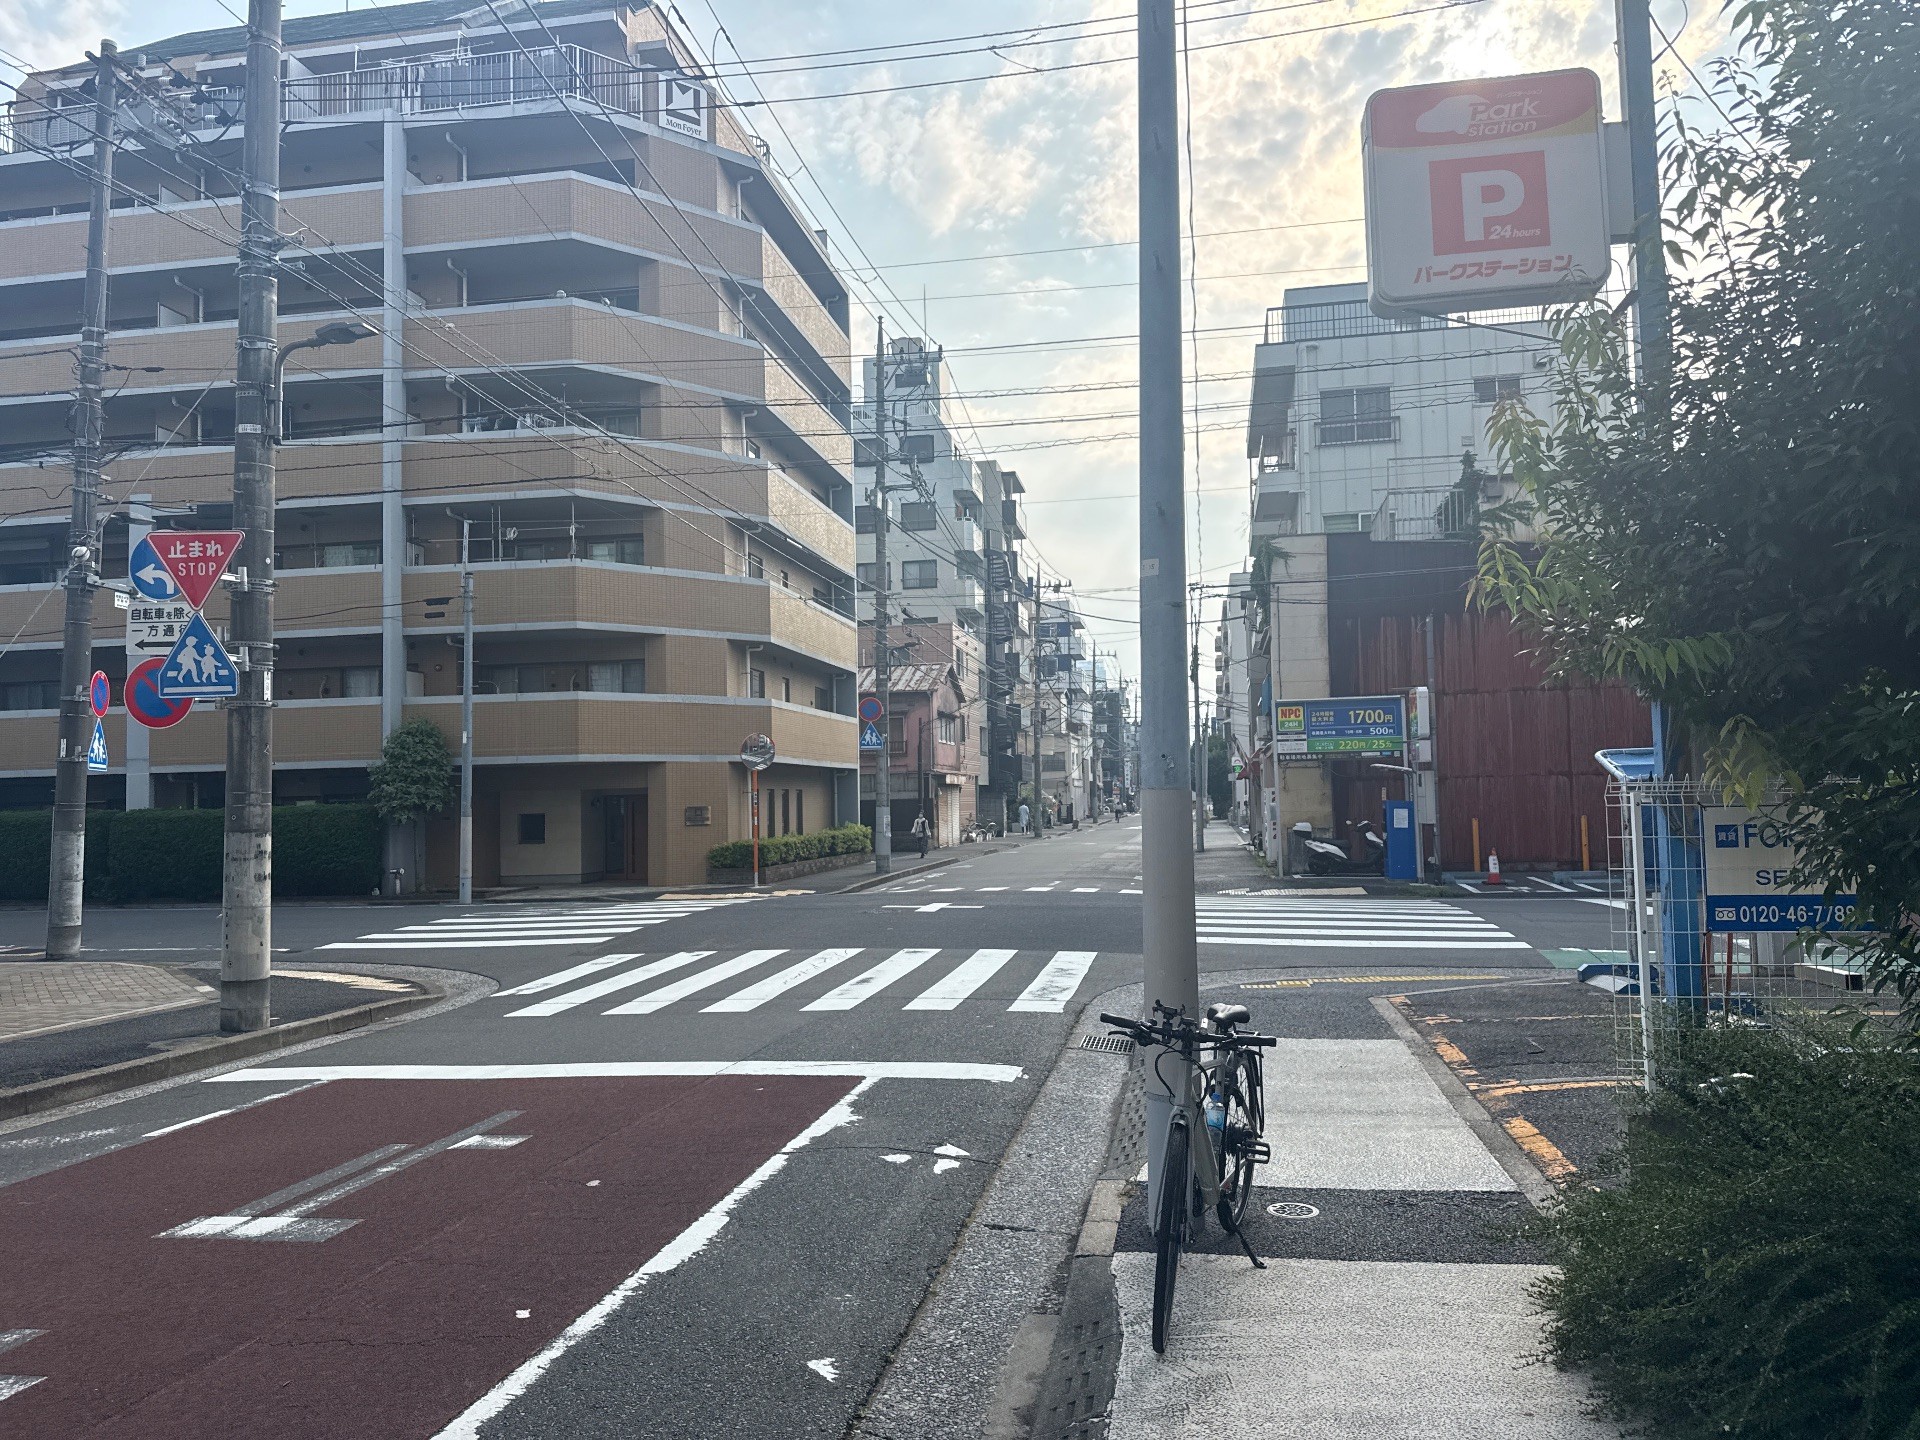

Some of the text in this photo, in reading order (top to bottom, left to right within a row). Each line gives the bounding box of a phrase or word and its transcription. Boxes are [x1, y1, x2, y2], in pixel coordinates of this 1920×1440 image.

[1470, 97, 1540, 122] Park
[1468, 120, 1537, 137] station
[1460, 169, 1525, 242] P
[1489, 224, 1541, 240] 24 hours
[1413, 255, 1573, 284] パークステーション
[168, 540, 225, 558] 止まれ
[178, 562, 217, 576] STOP
[131, 607, 192, 621] 自転車を除く
[1280, 708, 1301, 719] NPC
[1348, 709, 1393, 724] 1700円
[1284, 720, 1299, 728] 24H
[1370, 727, 1394, 735] 500円
